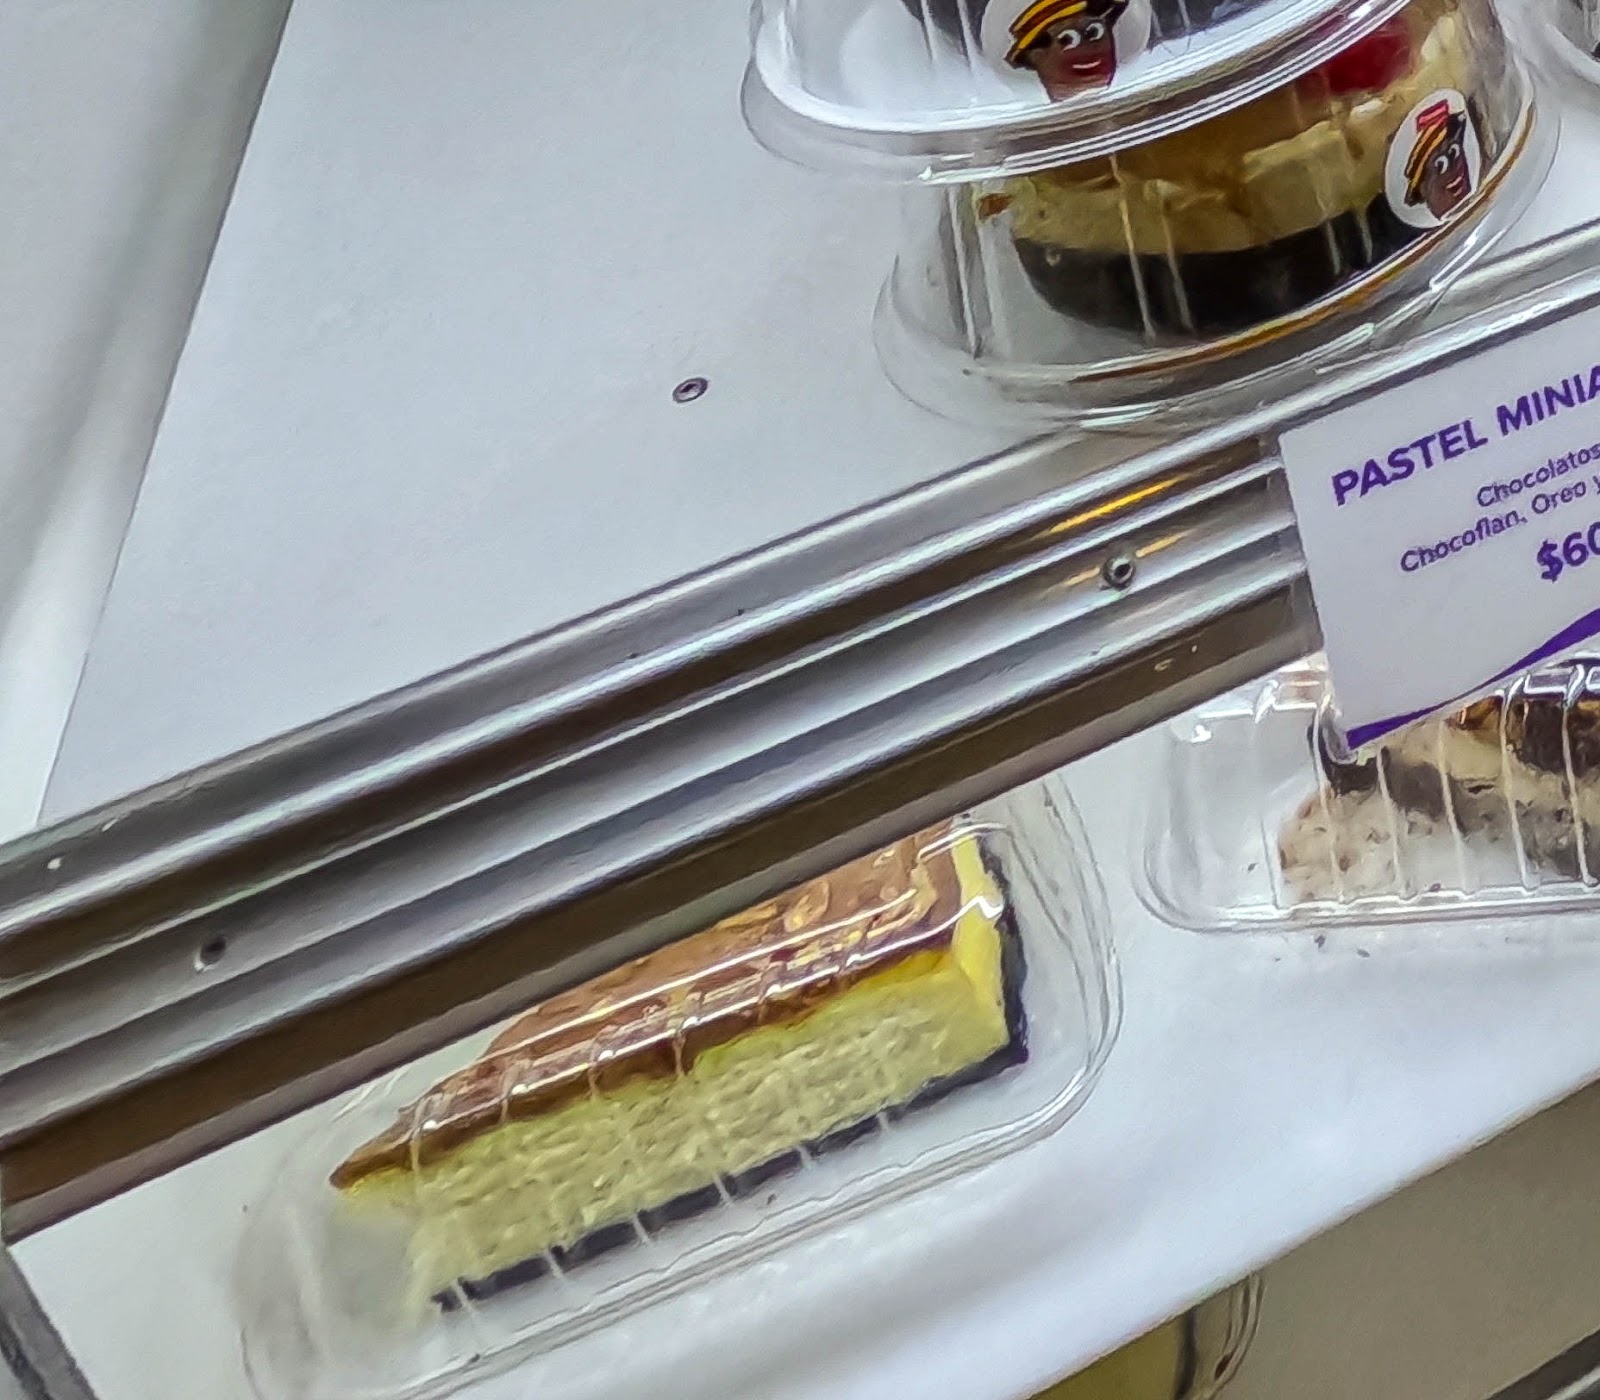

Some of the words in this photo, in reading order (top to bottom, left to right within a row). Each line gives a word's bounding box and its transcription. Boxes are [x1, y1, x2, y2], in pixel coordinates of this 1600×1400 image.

[1331, 419, 1489, 507] PASTEL
[1400, 510, 1528, 572] Chocoflan,
[1531, 480, 1587, 517] Oreo
